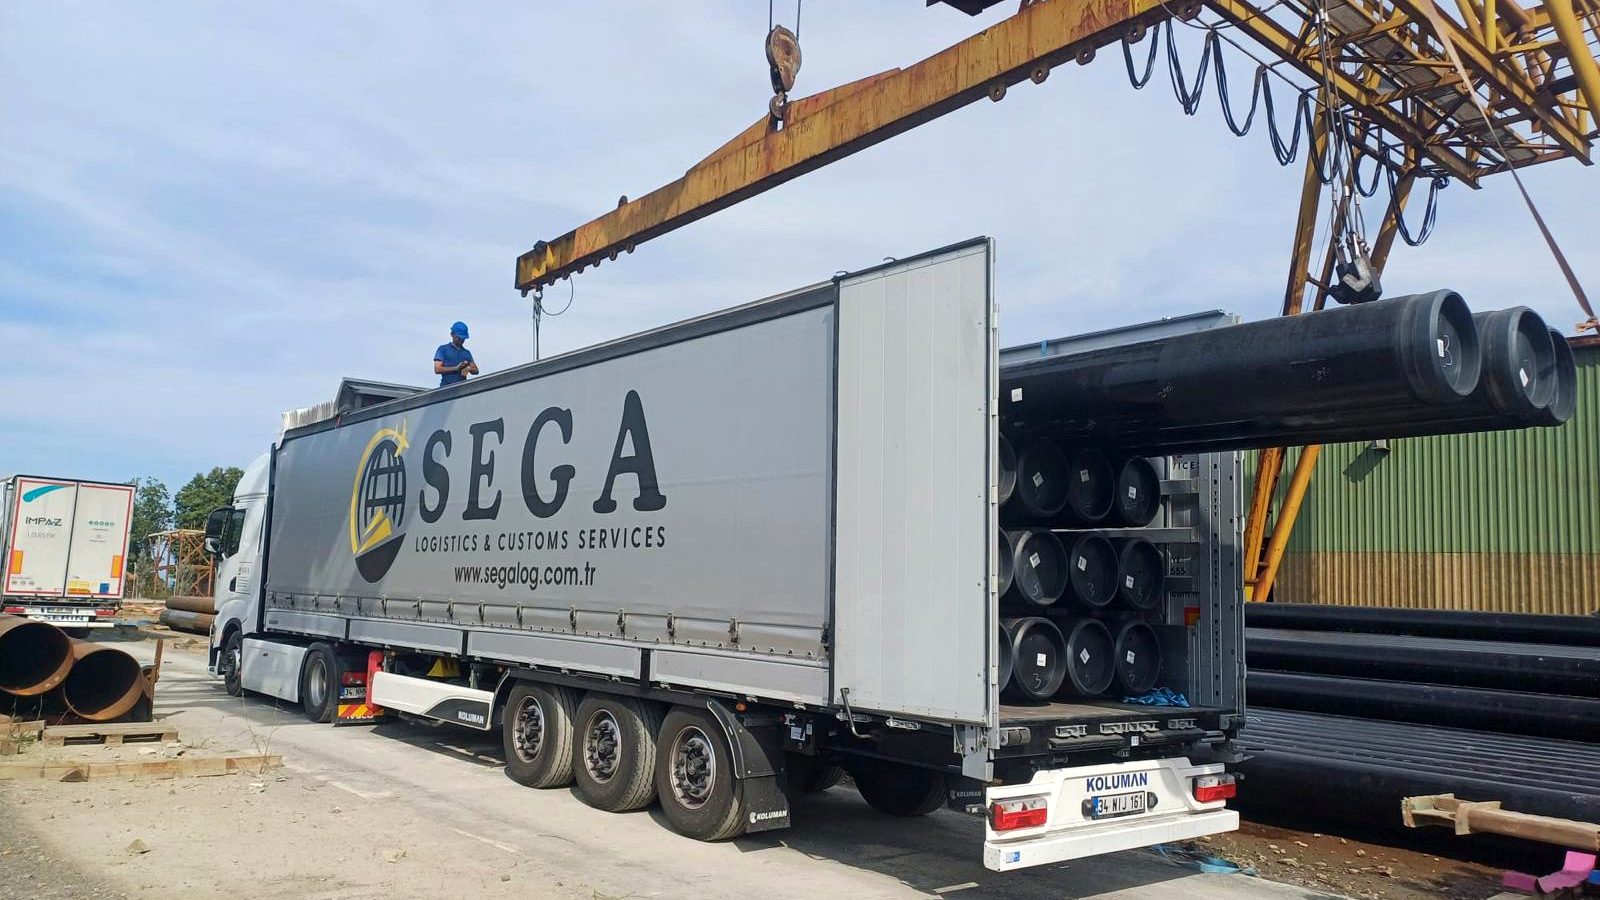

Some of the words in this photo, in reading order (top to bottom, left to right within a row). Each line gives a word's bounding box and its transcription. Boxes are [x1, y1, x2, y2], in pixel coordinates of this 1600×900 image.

[419, 389, 667, 524] SEGA
[415, 534, 478, 552] LOGISTICS
[483, 533, 491, 551] &
[498, 530, 569, 550] CUSTOMS
[578, 526, 666, 549] SERVICES
[454, 562, 597, 590] www.segalog.com.tr
[458, 711, 485, 724] KOLUMAN
[1086, 772, 1147, 791] KOLUMAN
[1098, 798, 1109, 813] 34
[1112, 796, 1127, 812] NIJ
[1130, 794, 1143, 809] 161
[756, 810, 788, 821] KOLUMAN
